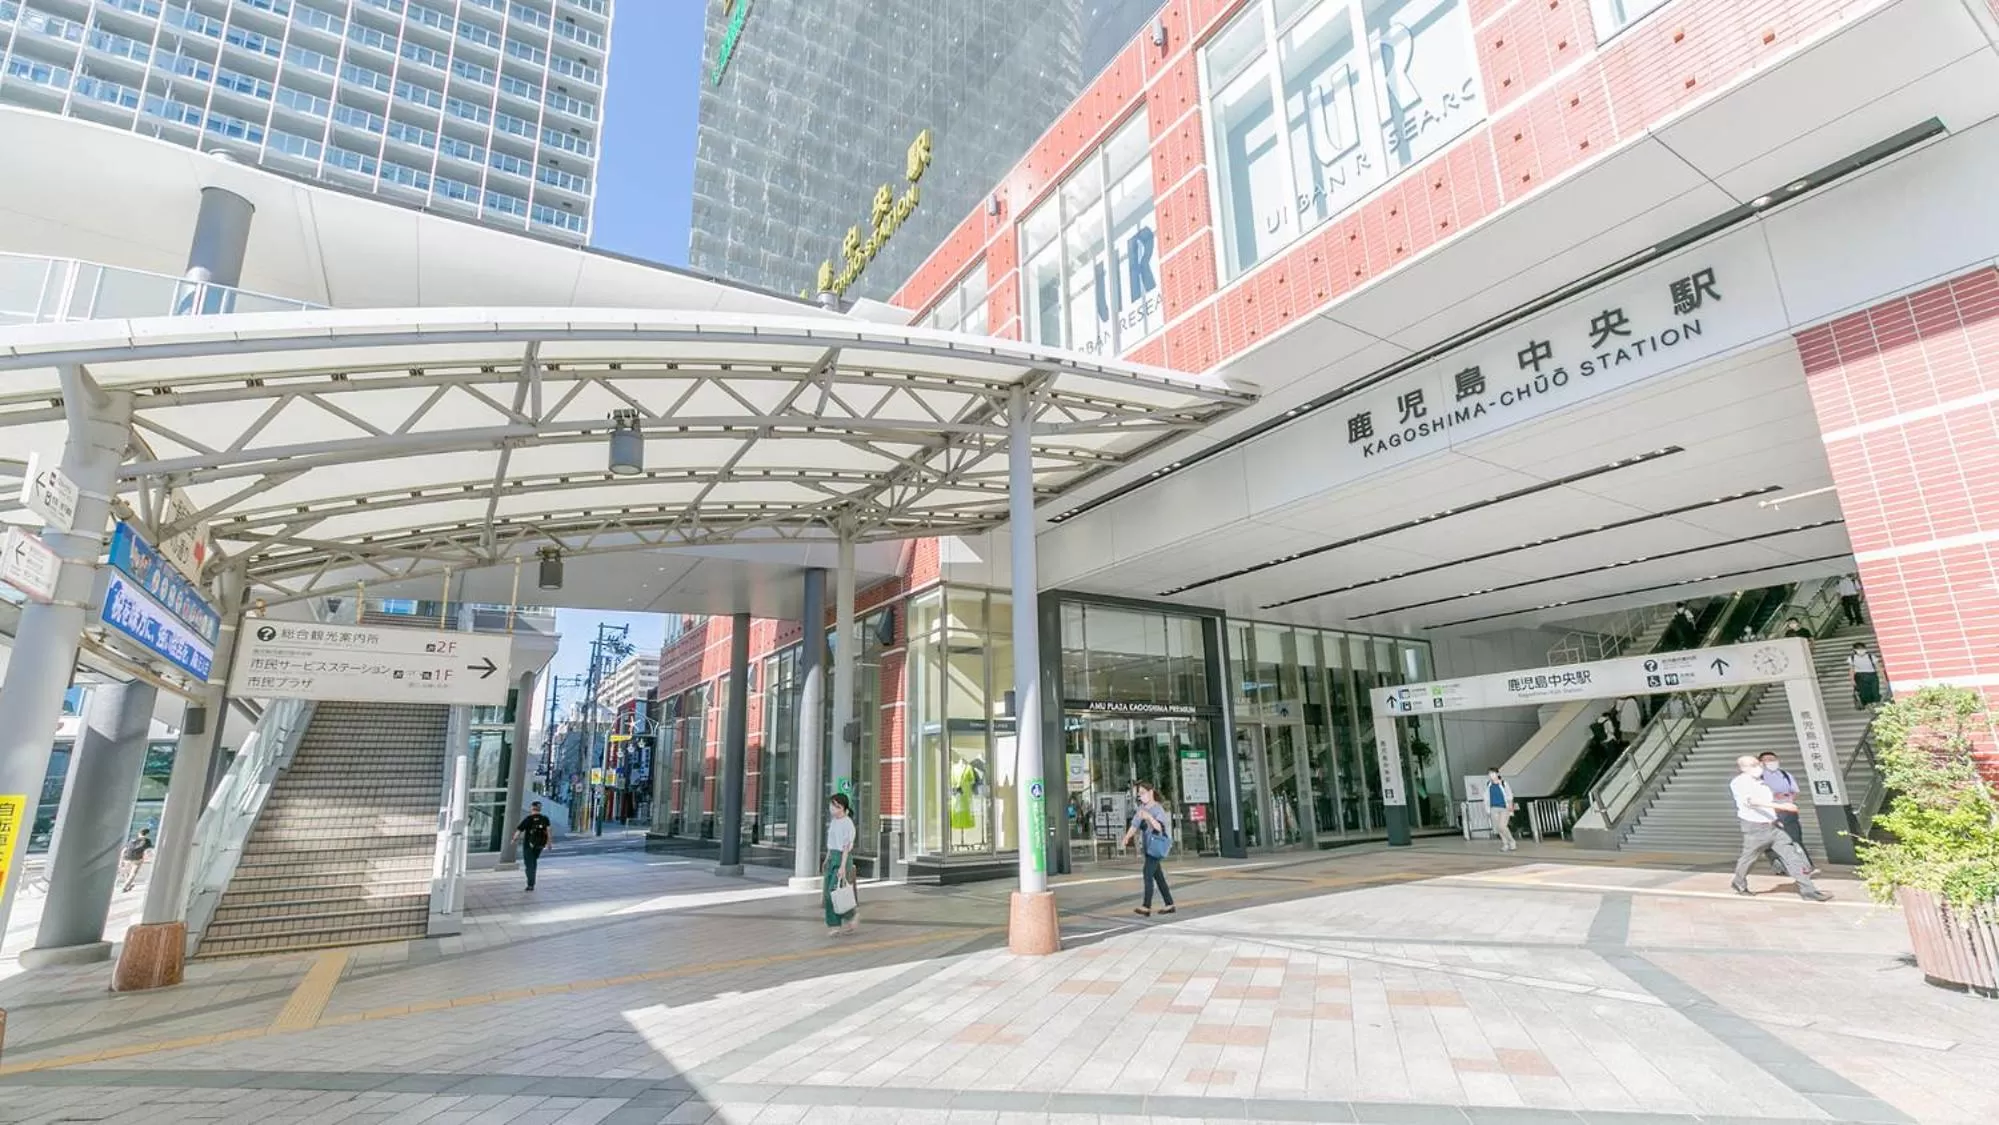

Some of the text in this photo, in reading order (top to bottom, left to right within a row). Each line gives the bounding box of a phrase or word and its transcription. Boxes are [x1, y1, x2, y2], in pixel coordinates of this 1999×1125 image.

[1267, 78, 1476, 234] UBAN RSEARC
[1346, 267, 1722, 444] 鹿児島中央駅
[1580, 319, 1702, 377] STATION
[281, 628, 379, 645] 総合観光案内所
[436, 640, 457, 653] 2F
[250, 658, 391, 675] 市民サービスステーション
[435, 669, 454, 681] 1F
[247, 676, 313, 689] 市民プラザ
[1508, 670, 1592, 692] 鹿児島中央駅
[1107, 702, 1128, 712] PLAZA
